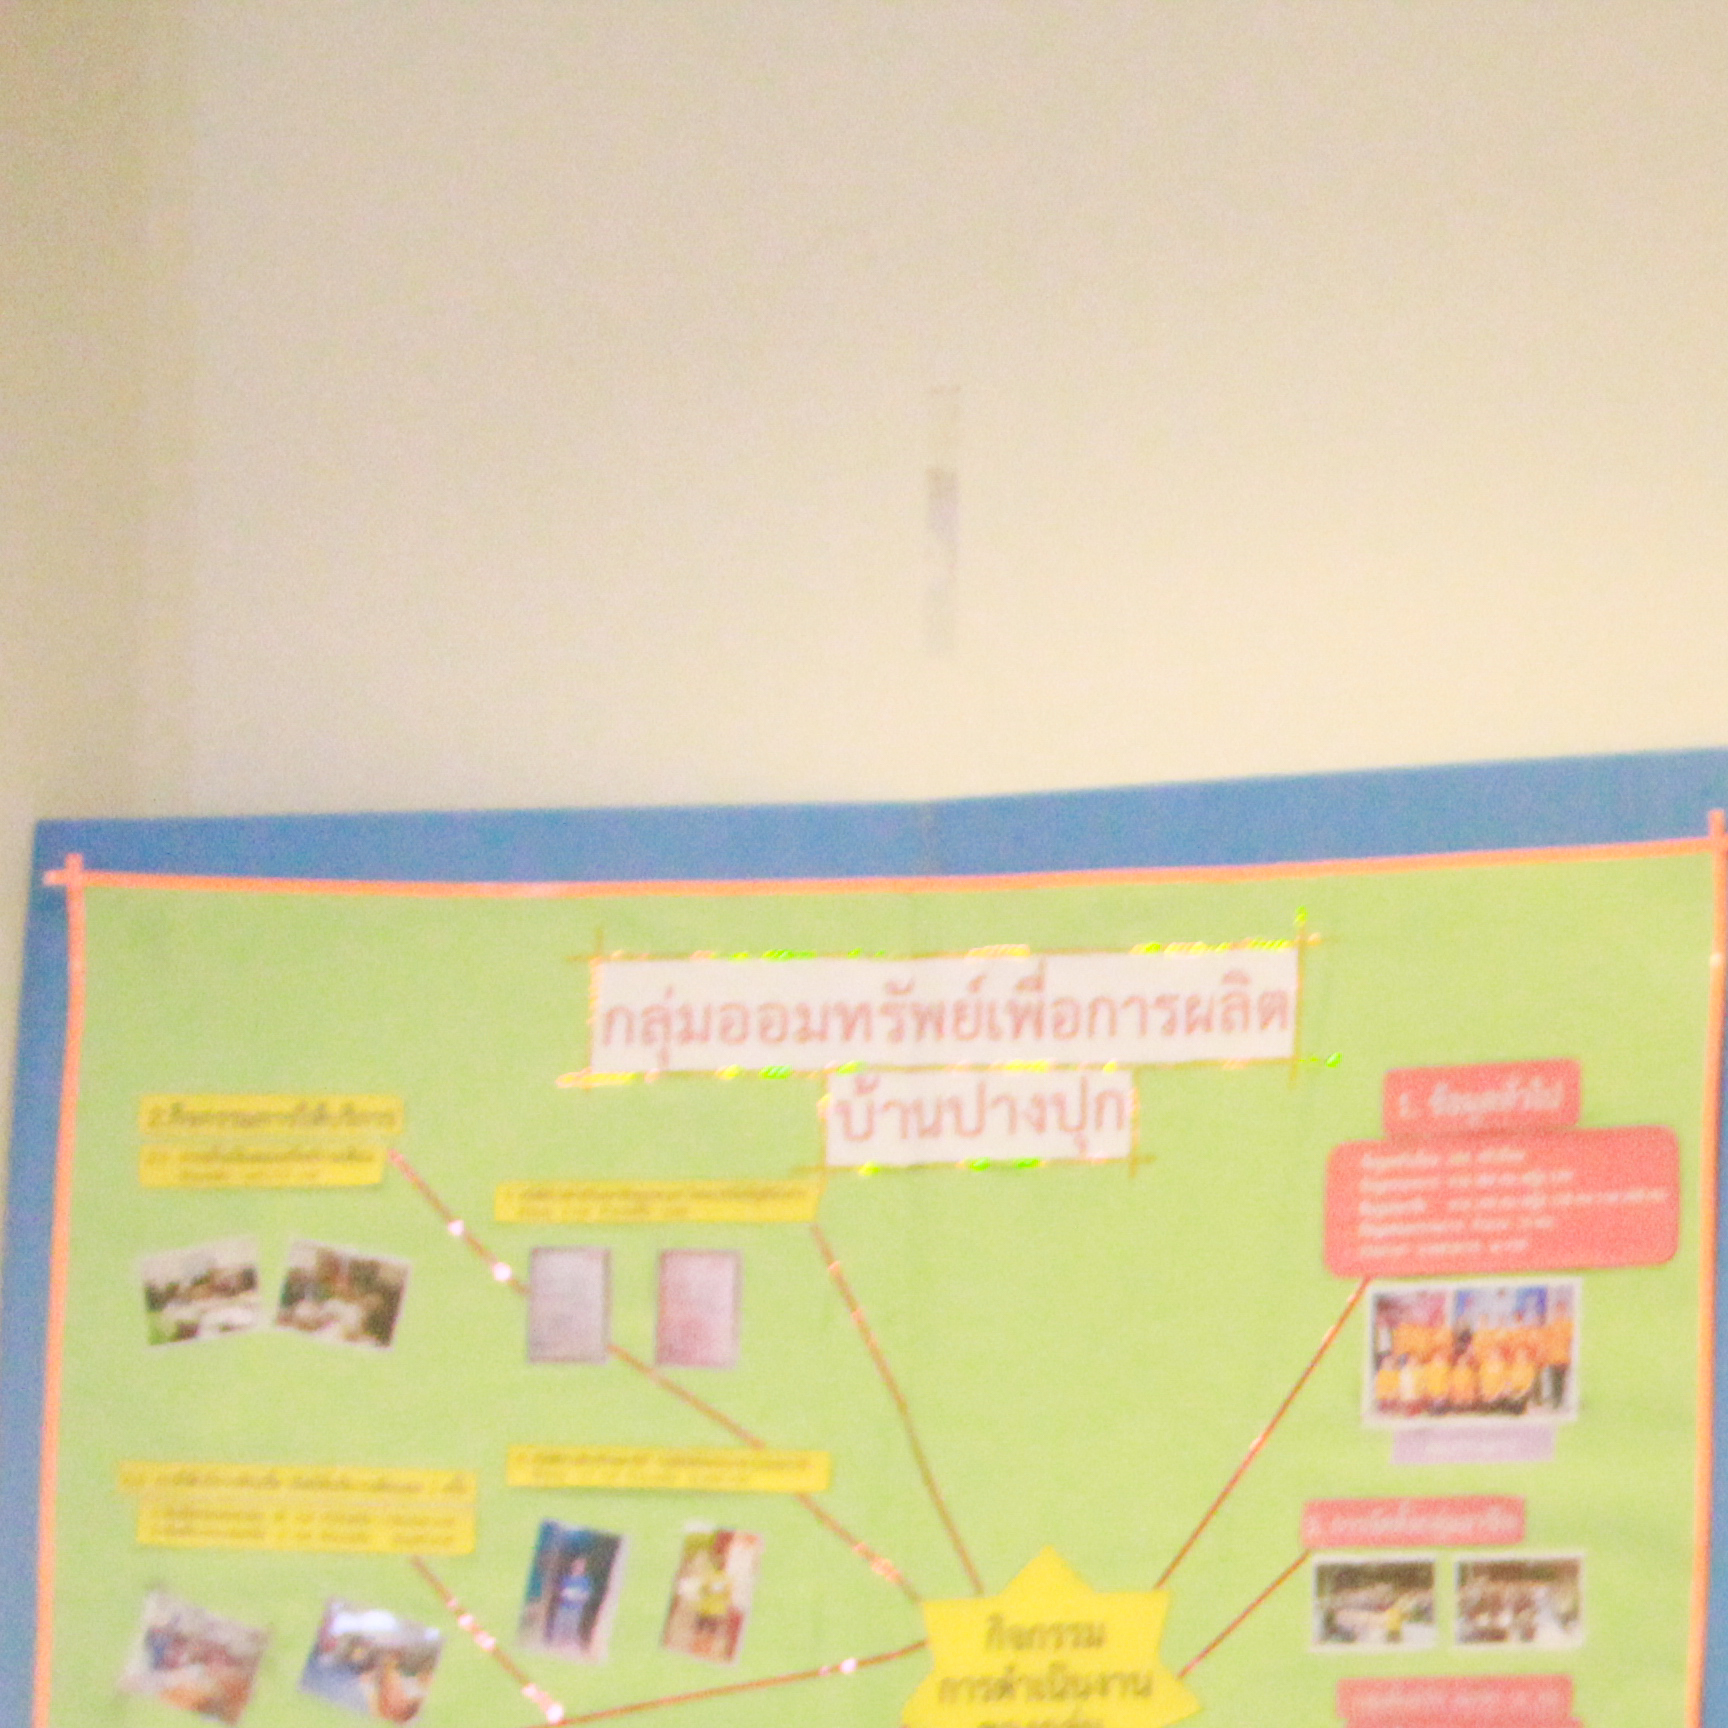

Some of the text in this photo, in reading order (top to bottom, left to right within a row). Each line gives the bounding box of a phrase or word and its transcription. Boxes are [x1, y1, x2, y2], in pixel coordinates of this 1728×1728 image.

[602, 957, 1289, 1069] กลุ่มออมทรัพย์เพื่อการผลิต
[834, 1074, 1126, 1158] บ้านปางปุก
[985, 1611, 1106, 1651] กิจกรรม
[937, 1659, 1154, 1703] การดำเนินงาน
